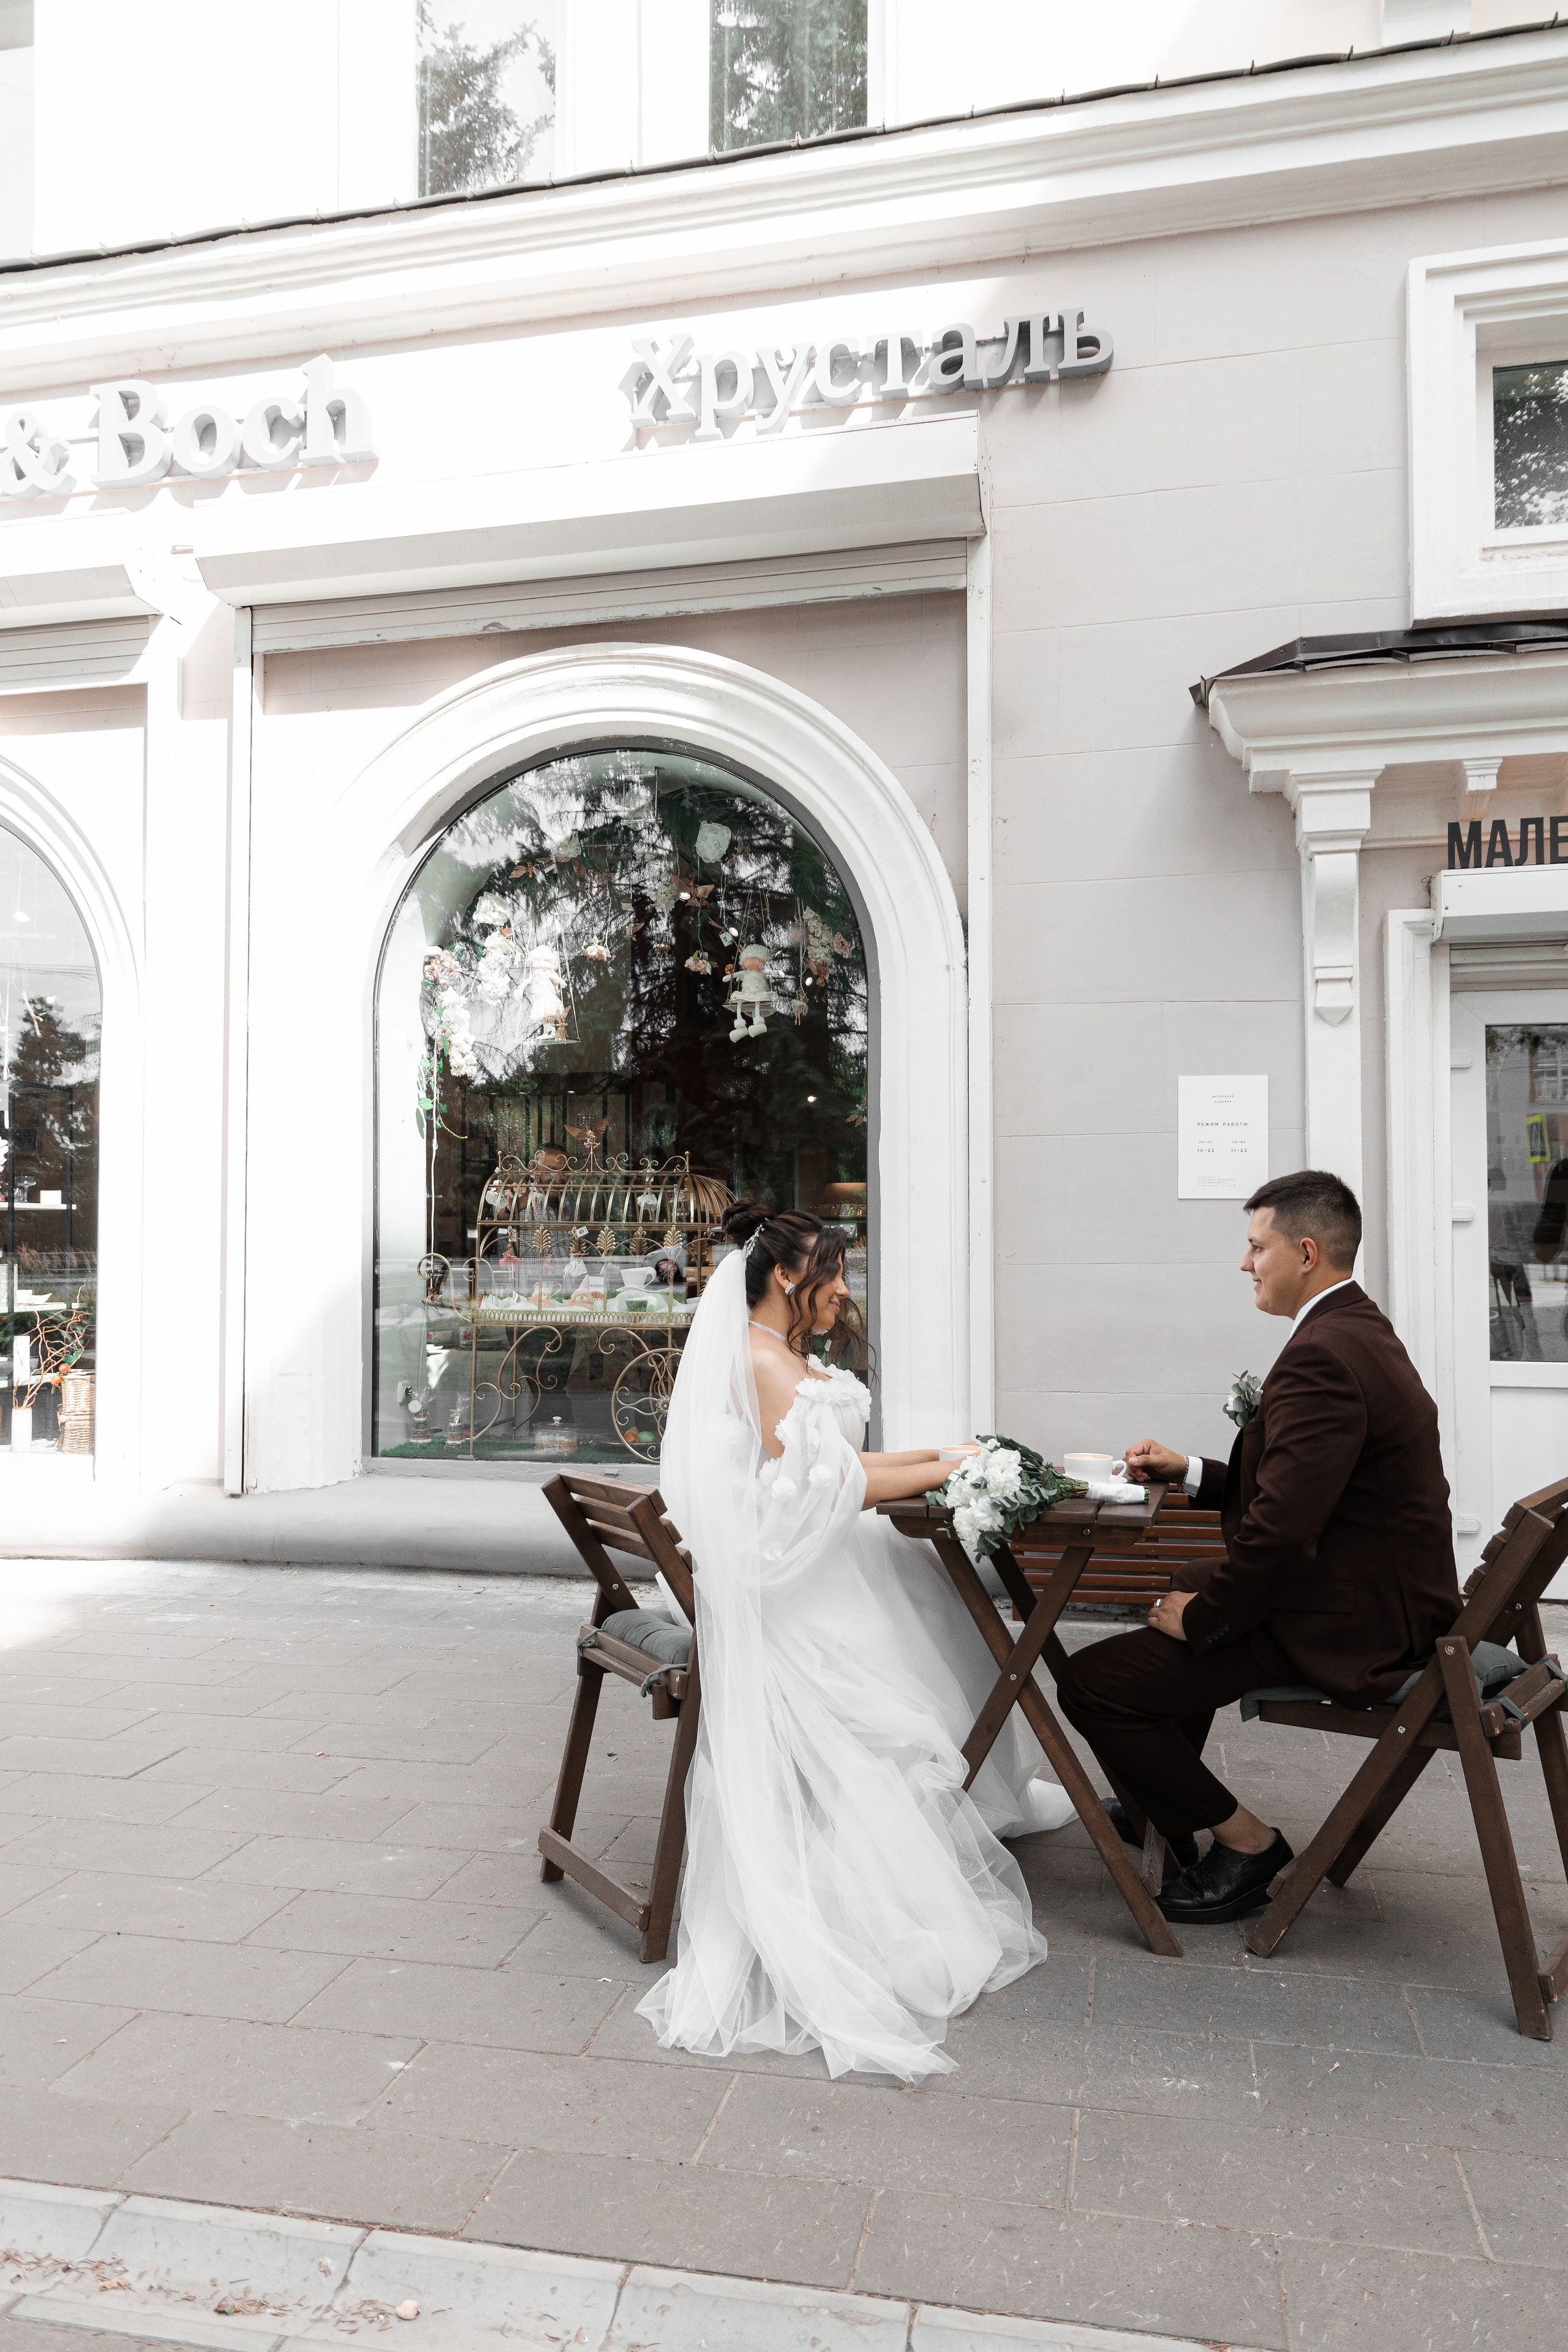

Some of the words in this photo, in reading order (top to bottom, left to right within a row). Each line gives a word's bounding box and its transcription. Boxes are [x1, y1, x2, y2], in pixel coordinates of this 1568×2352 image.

[0, 411, 77, 501] &
[89, 353, 380, 489] Boch
[630, 307, 1114, 440] Хрусталь
[1447, 815, 1568, 870] МАЛЕ
